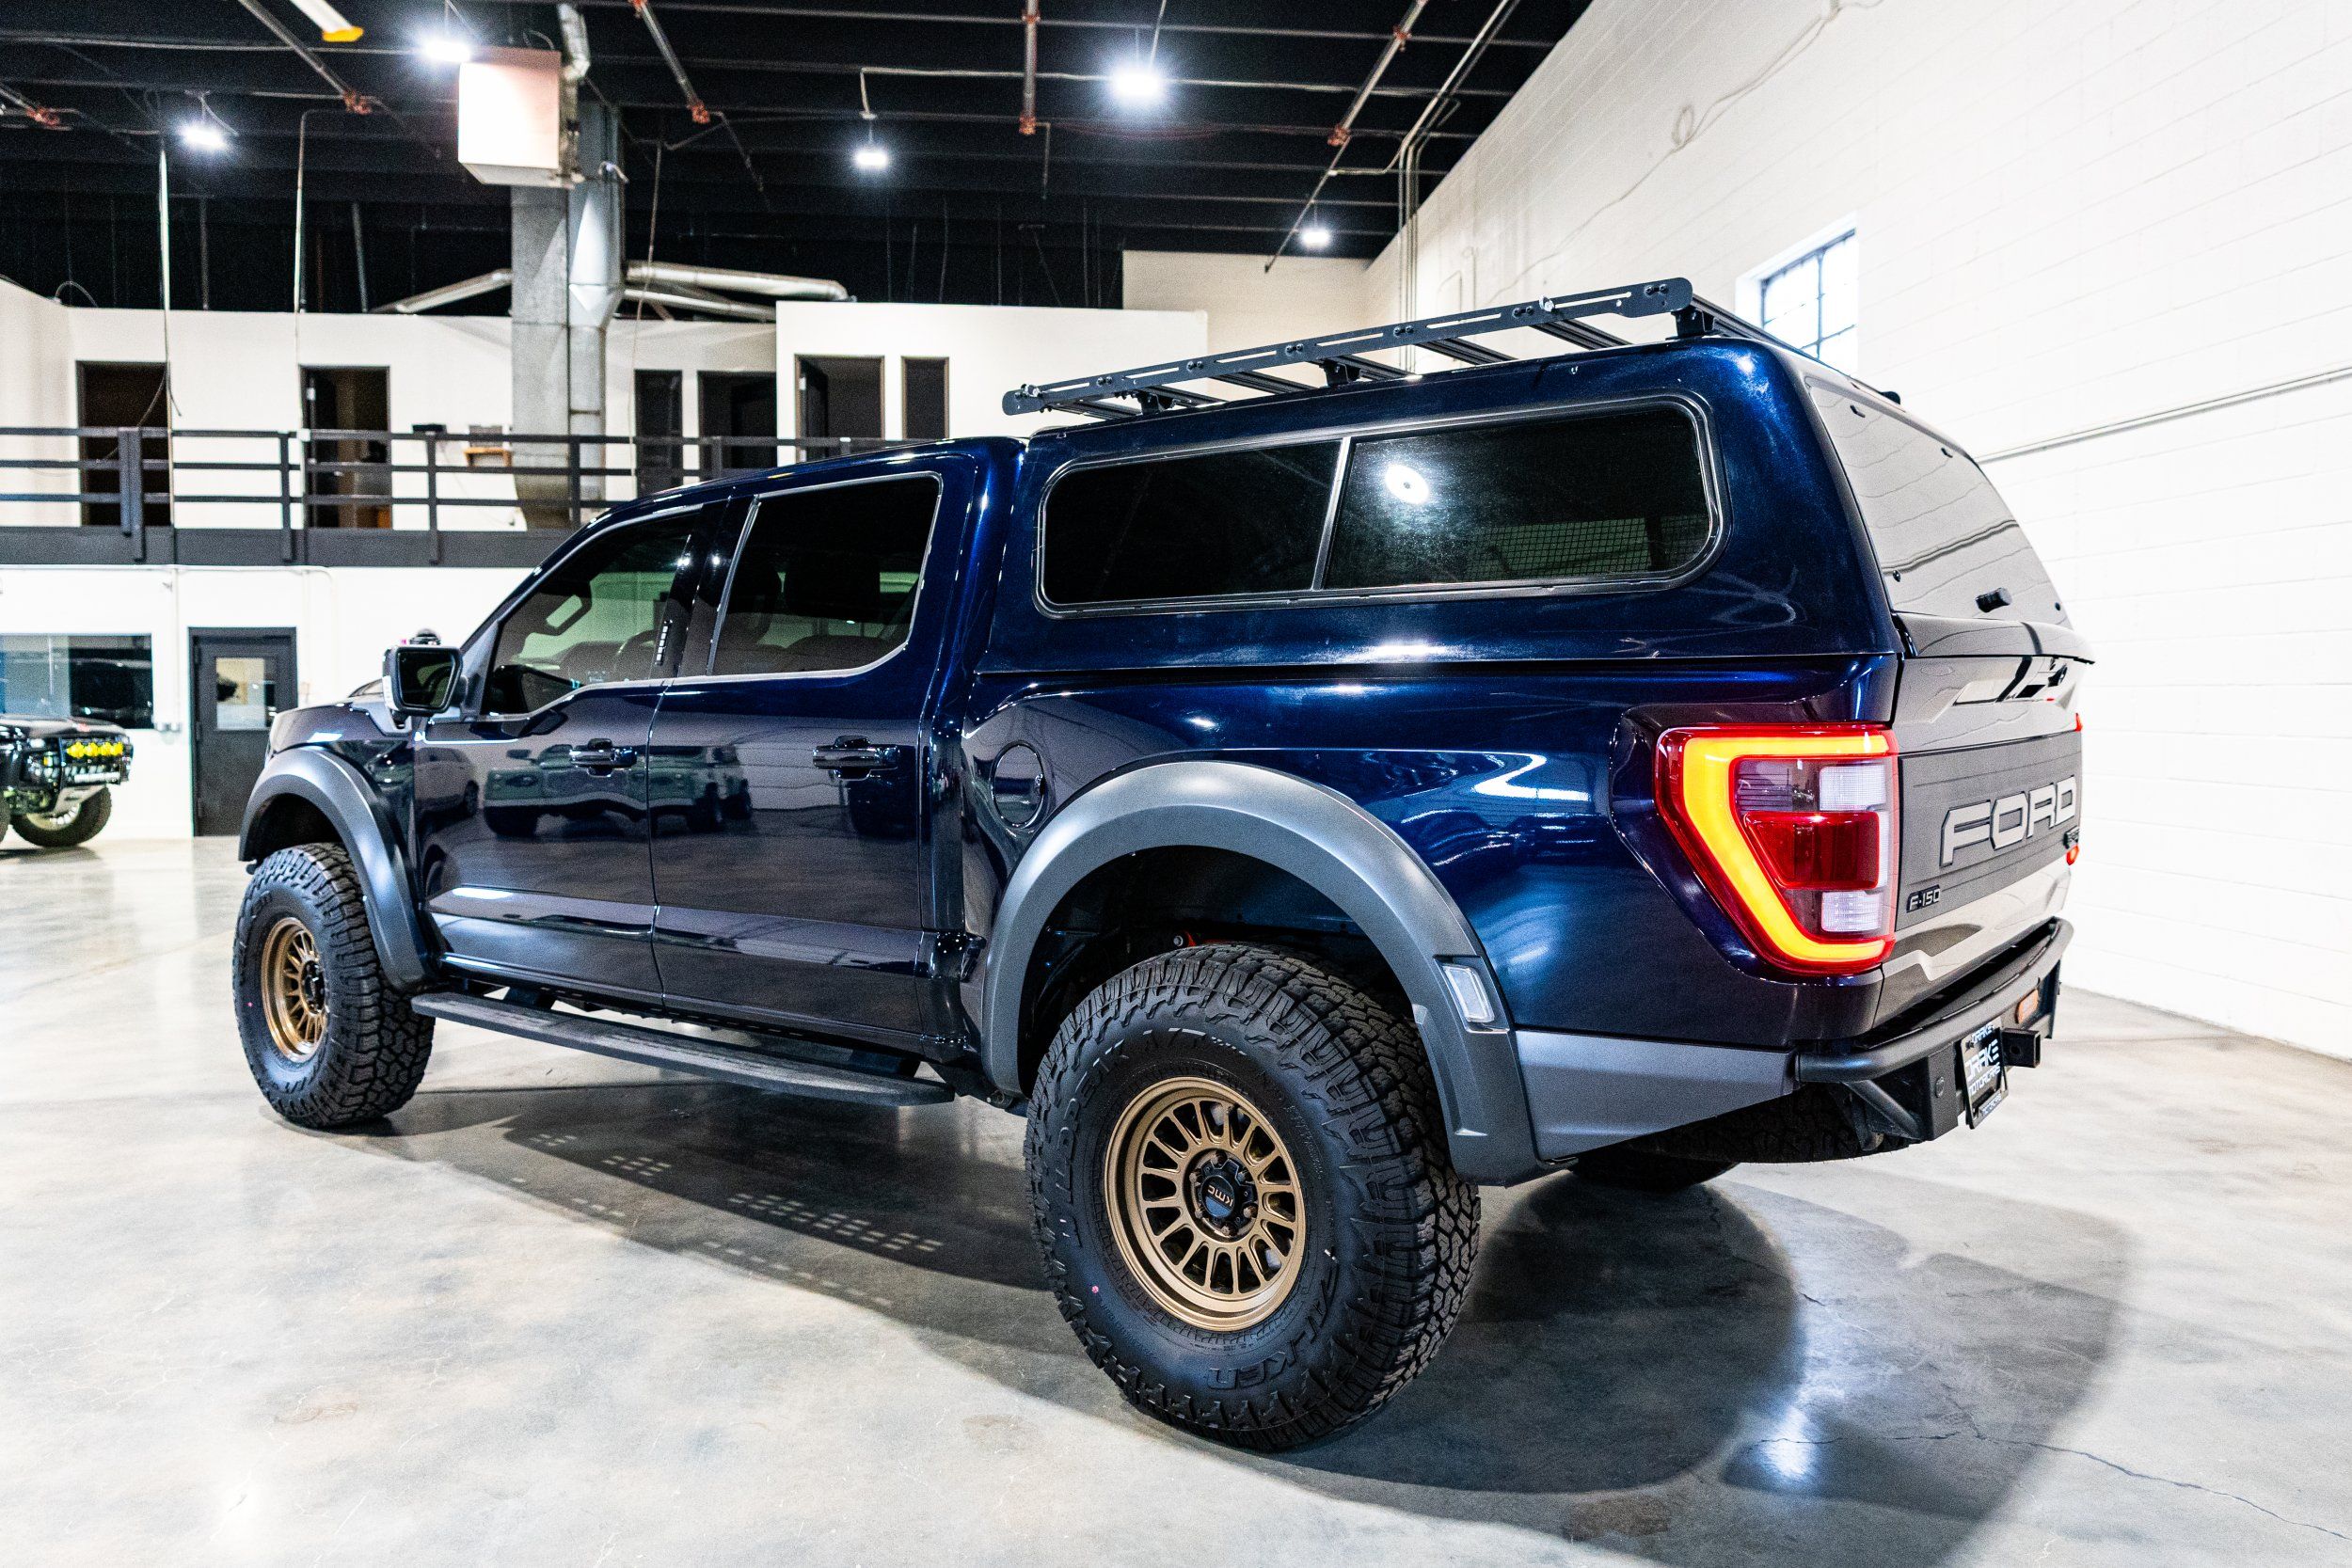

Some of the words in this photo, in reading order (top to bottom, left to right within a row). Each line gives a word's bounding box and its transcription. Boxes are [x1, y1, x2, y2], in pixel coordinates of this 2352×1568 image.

[1939, 775, 2077, 868] FORD
[1909, 887, 1941, 911] F-150
[1963, 1038, 2000, 1083] DRAKE
